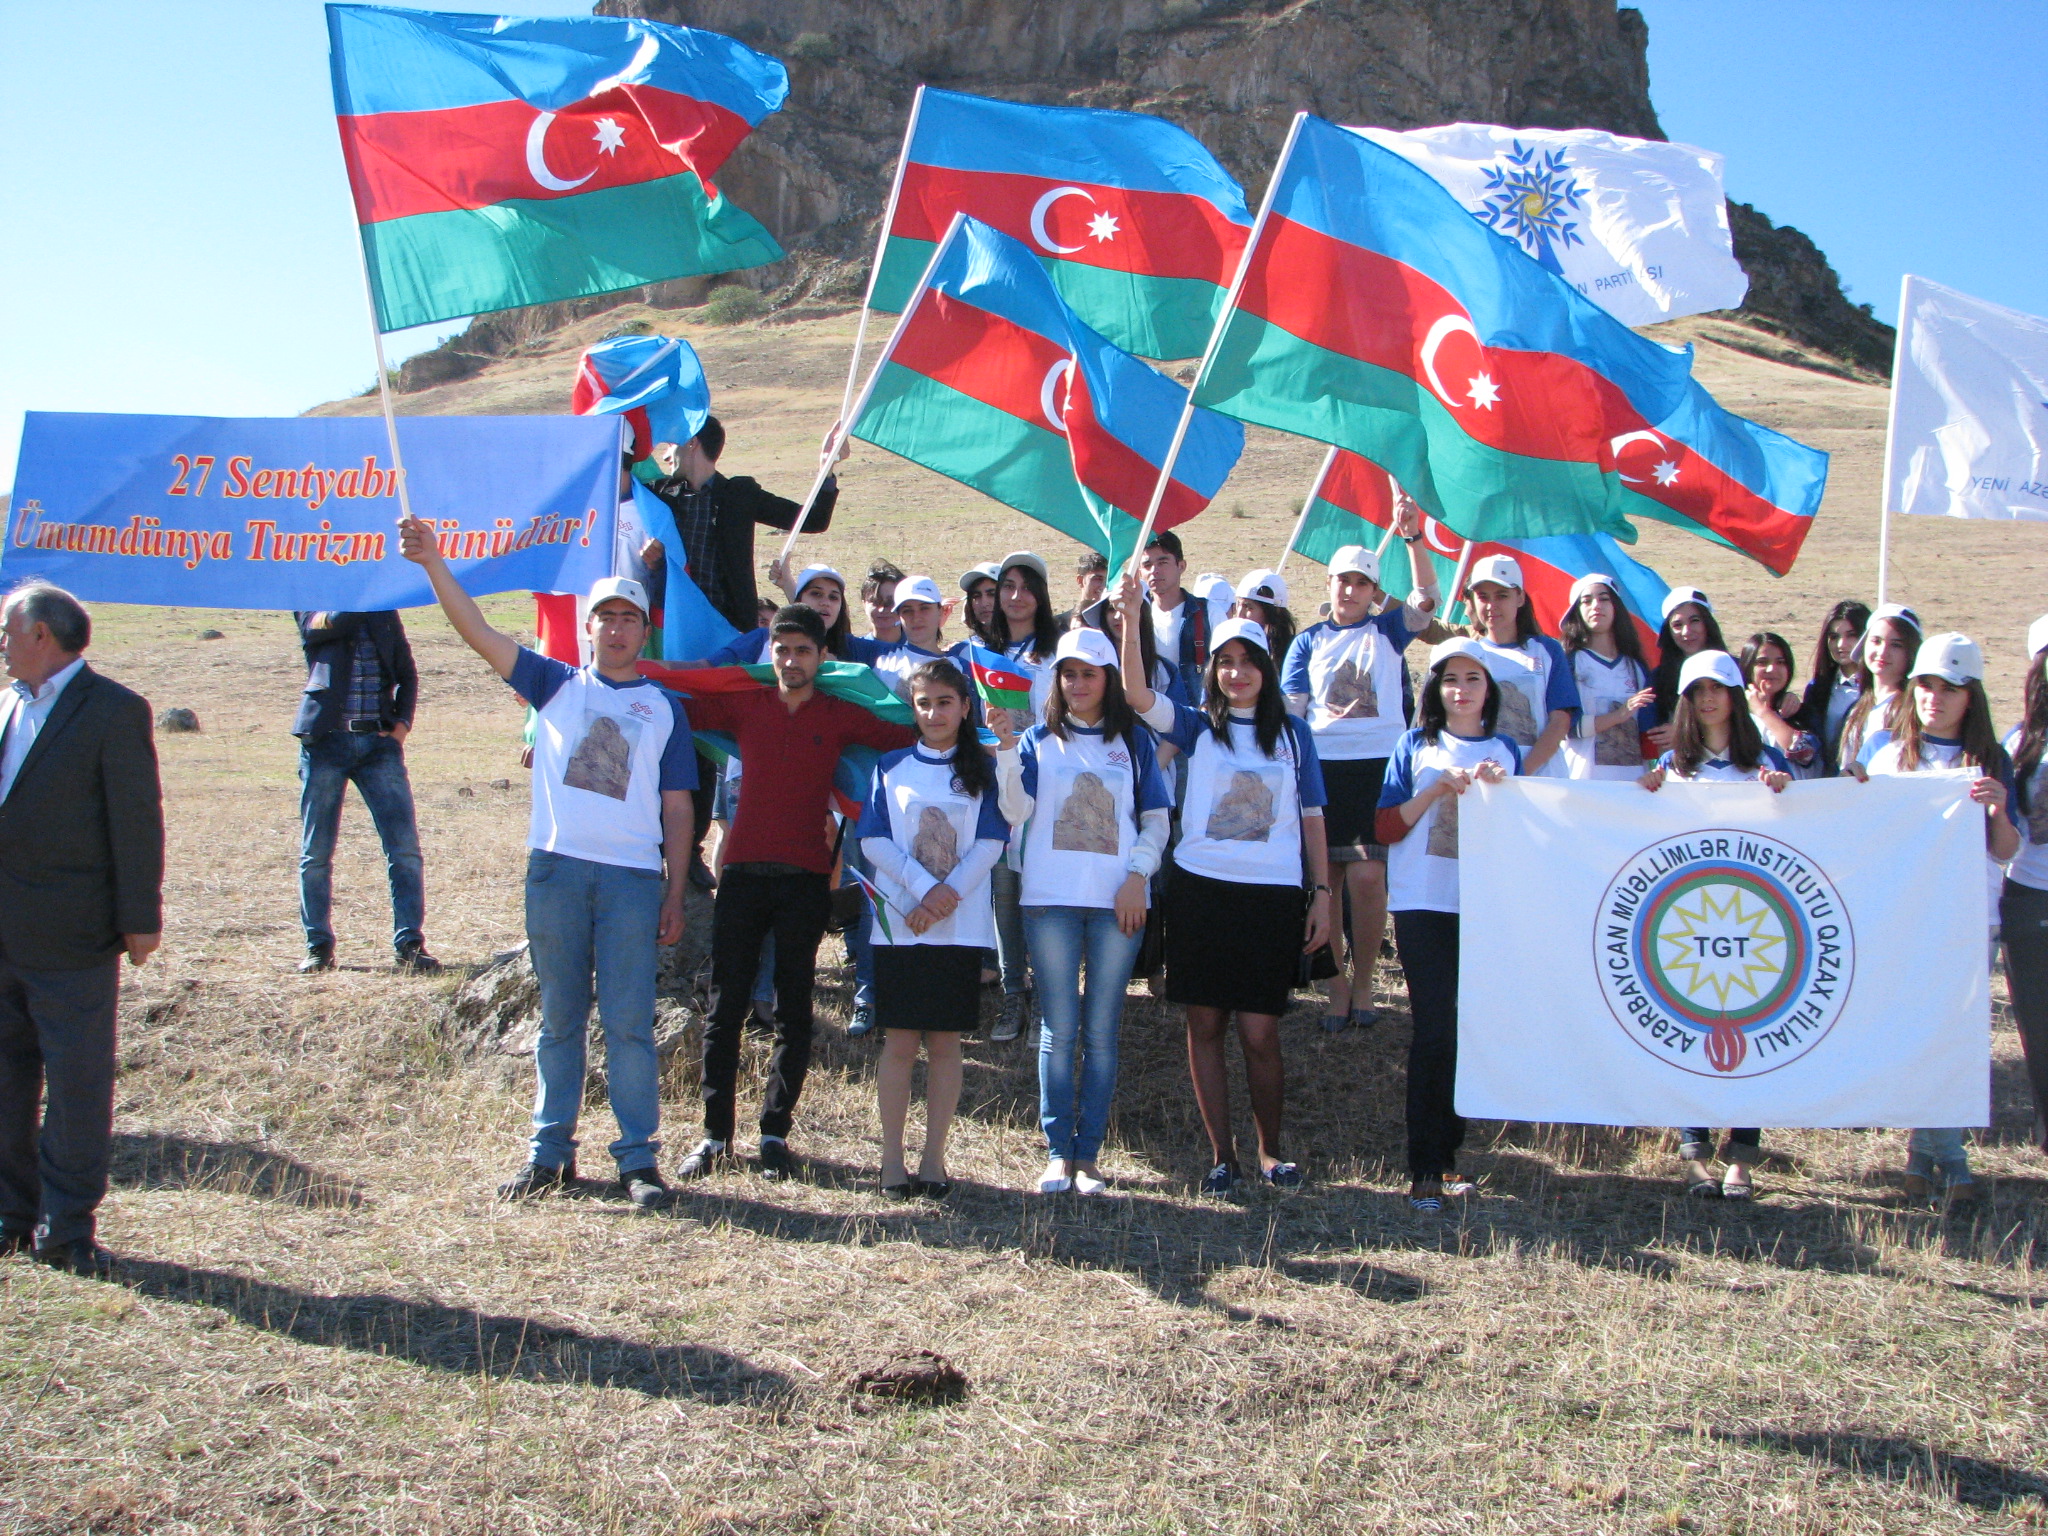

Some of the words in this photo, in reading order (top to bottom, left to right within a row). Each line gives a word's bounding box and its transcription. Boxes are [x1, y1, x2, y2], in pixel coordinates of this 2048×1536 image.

[168, 454, 215, 497] 27
[223, 456, 406, 510] Sentyabr
[1972, 476, 2011, 491] YENİ
[14, 500, 233, 569] Ümumdünya
[246, 519, 386, 566] Turizm
[1611, 838, 1729, 921] MÜƏLLİMLƏR
[1736, 836, 1833, 919] İNSTİTUTU
[1694, 936, 1749, 958] TGT
[1809, 925, 1840, 1000] QAZAX
[1607, 925, 1696, 1053] AZƏRBAYCAN
[1754, 999, 1823, 1057] FİLİALI
